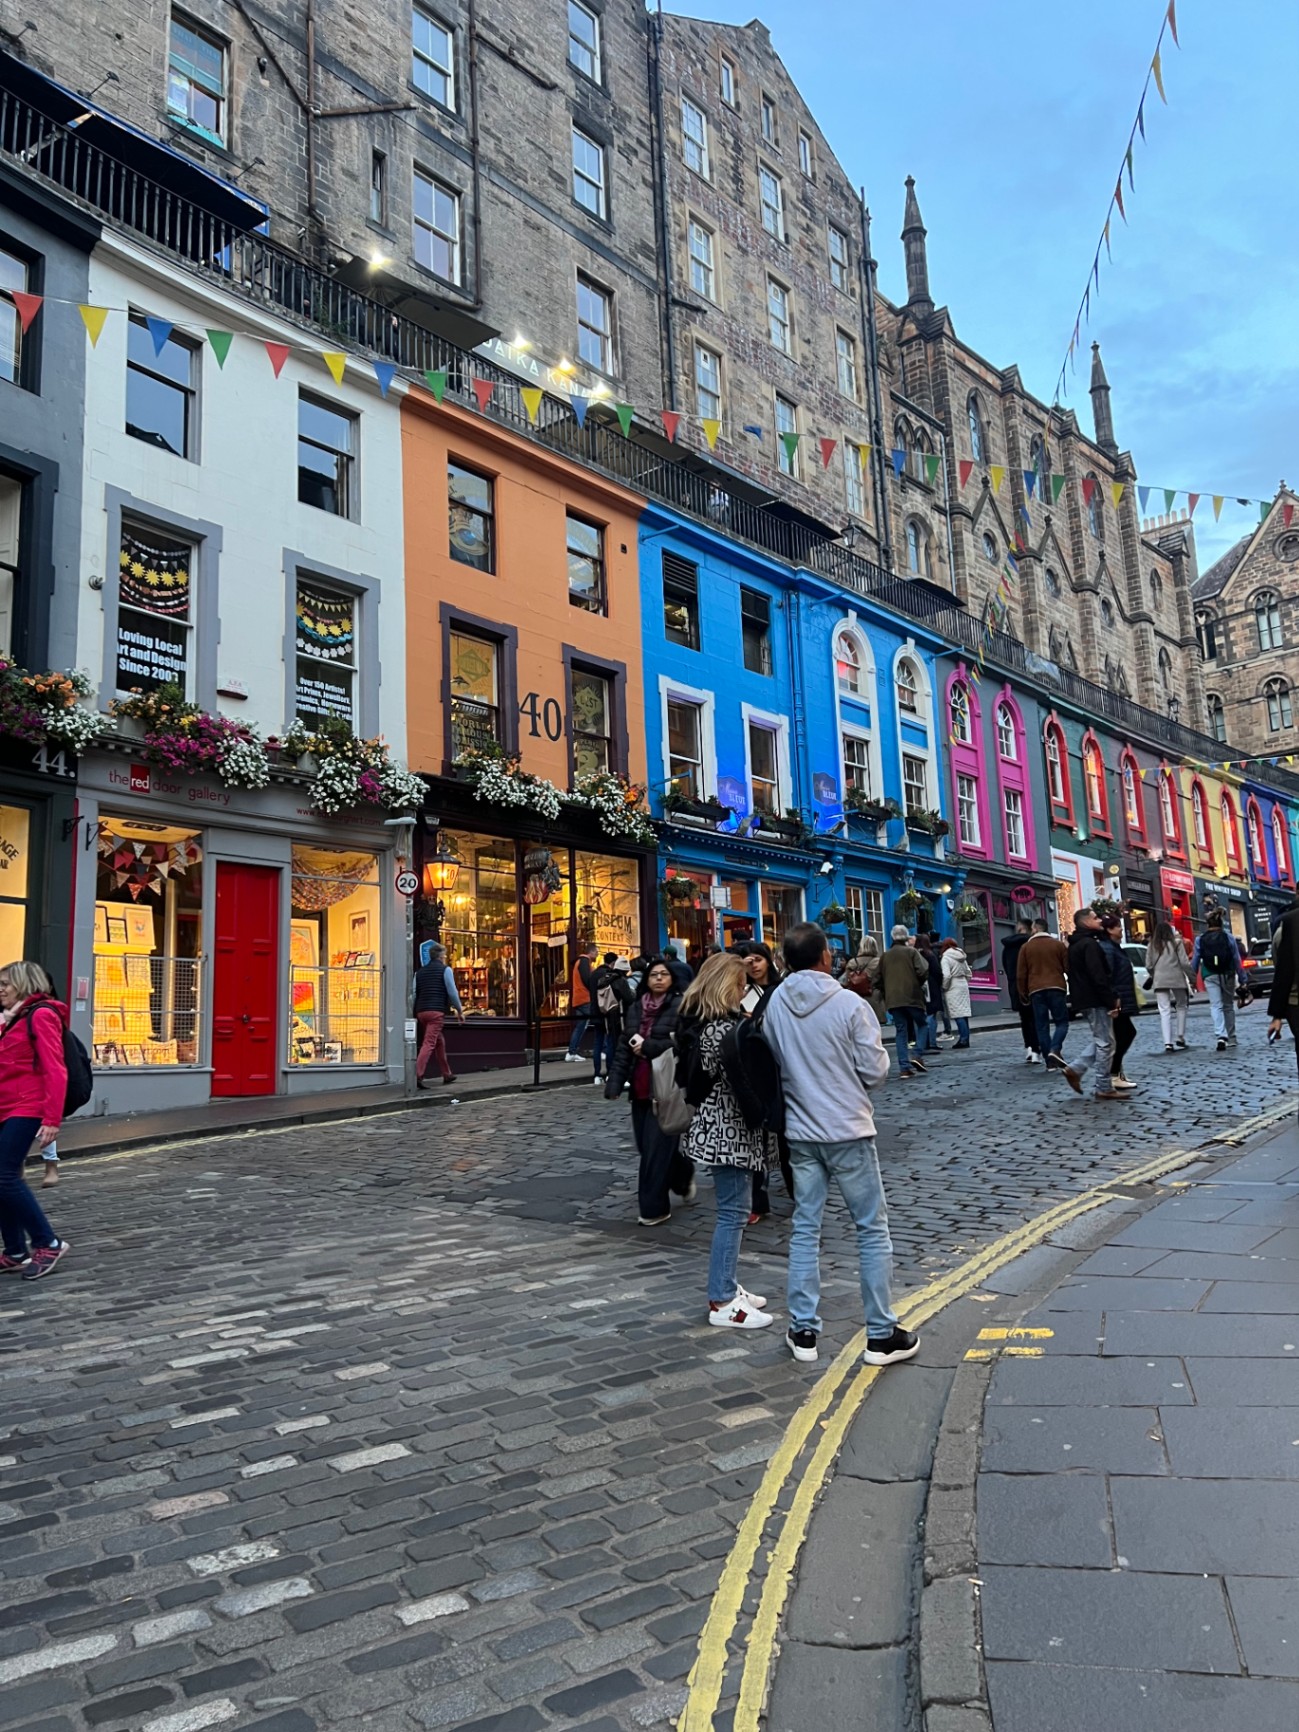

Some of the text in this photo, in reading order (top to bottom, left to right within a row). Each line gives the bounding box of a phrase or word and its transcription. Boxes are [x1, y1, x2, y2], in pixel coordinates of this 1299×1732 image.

[118, 627, 183, 656] Loving Local
[118, 657, 150, 677] Since
[129, 647, 150, 662] and
[151, 651, 187, 672] Design
[299, 676, 313, 687] Over
[519, 692, 562, 741] 40
[108, 768, 231, 805] the red door gallery
[399, 877, 417, 889] 20
[595, 913, 632, 934] USEUM
